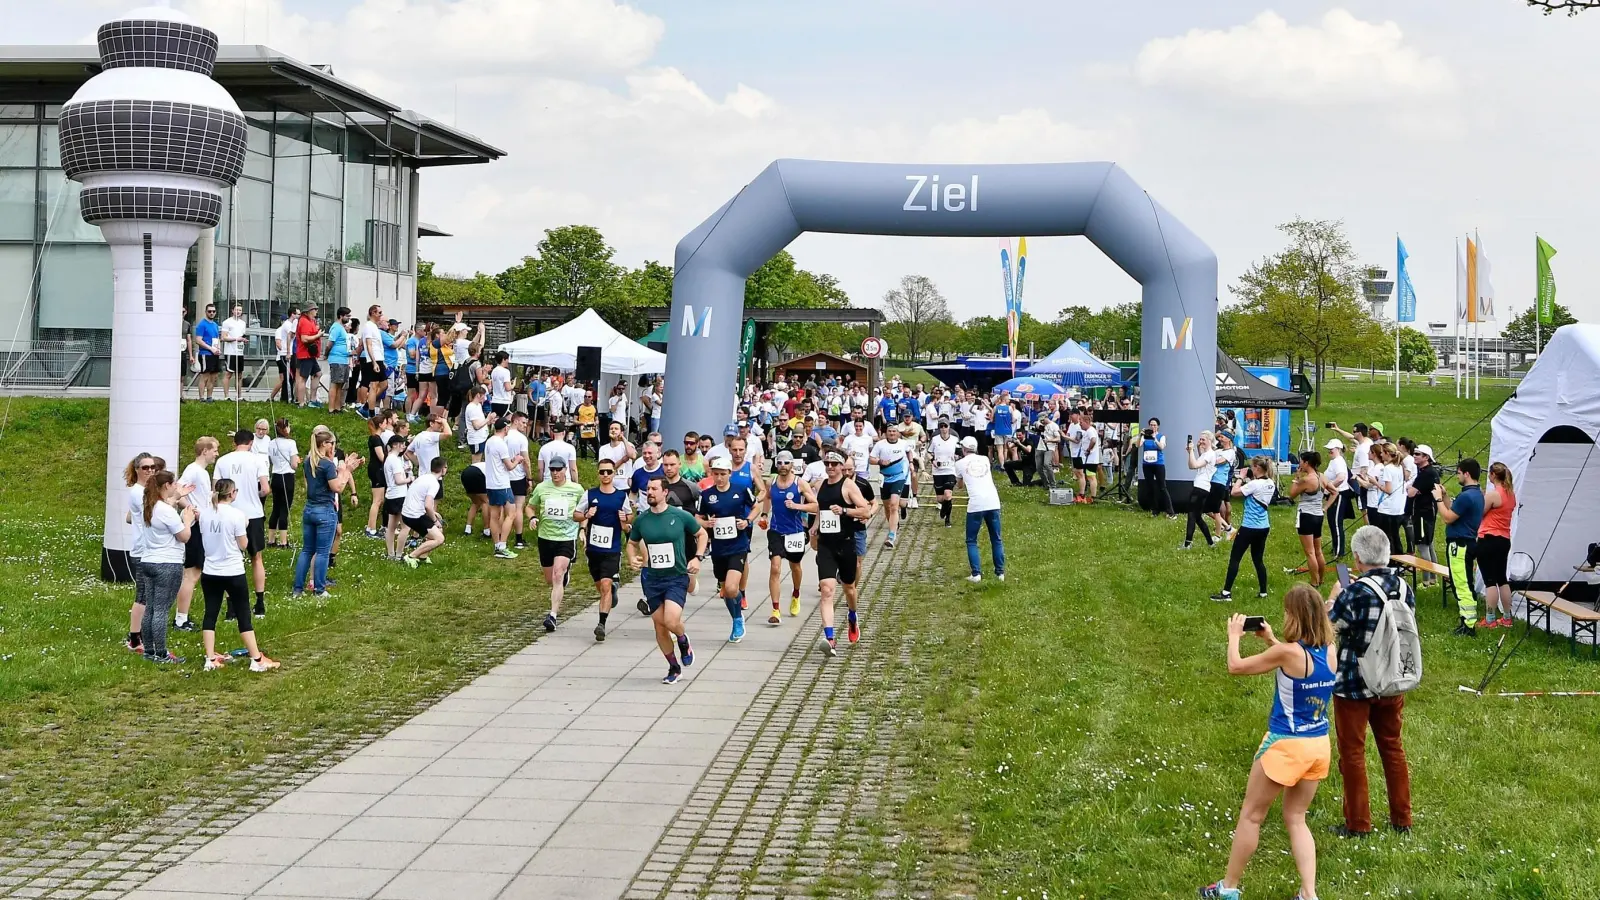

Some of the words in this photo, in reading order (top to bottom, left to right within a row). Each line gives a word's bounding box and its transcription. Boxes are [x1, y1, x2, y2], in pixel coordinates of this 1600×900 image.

[903, 174, 979, 212] Ziel
[547, 507, 565, 517] 221
[821, 520, 837, 529] 234
[715, 526, 734, 536] 212
[592, 534, 609, 544] 210
[787, 540, 803, 549] 246
[651, 554, 671, 564] 231
[1301, 682, 1319, 690] Team
